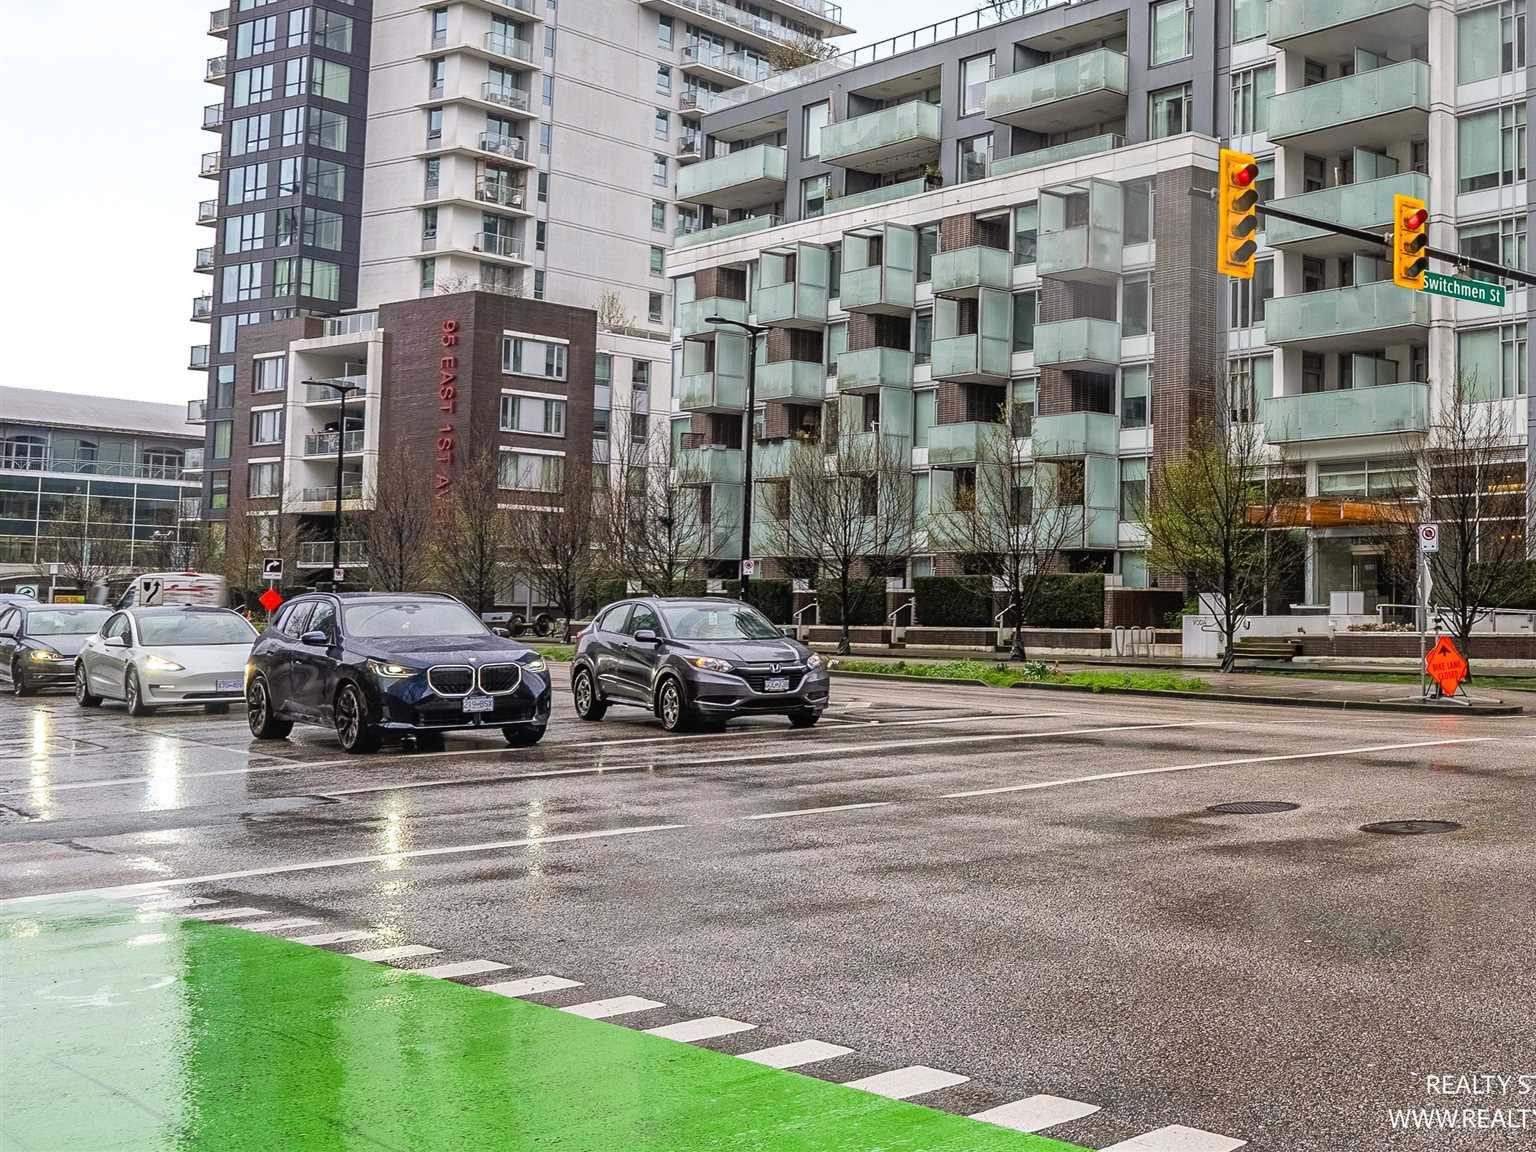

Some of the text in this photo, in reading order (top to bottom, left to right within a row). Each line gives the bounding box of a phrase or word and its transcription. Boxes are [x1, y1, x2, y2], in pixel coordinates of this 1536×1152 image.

[1424, 275, 1500, 302] Switchmen St
[441, 320, 456, 346] 95
[440, 356, 456, 414] EAST
[436, 424, 452, 464] 1ST
